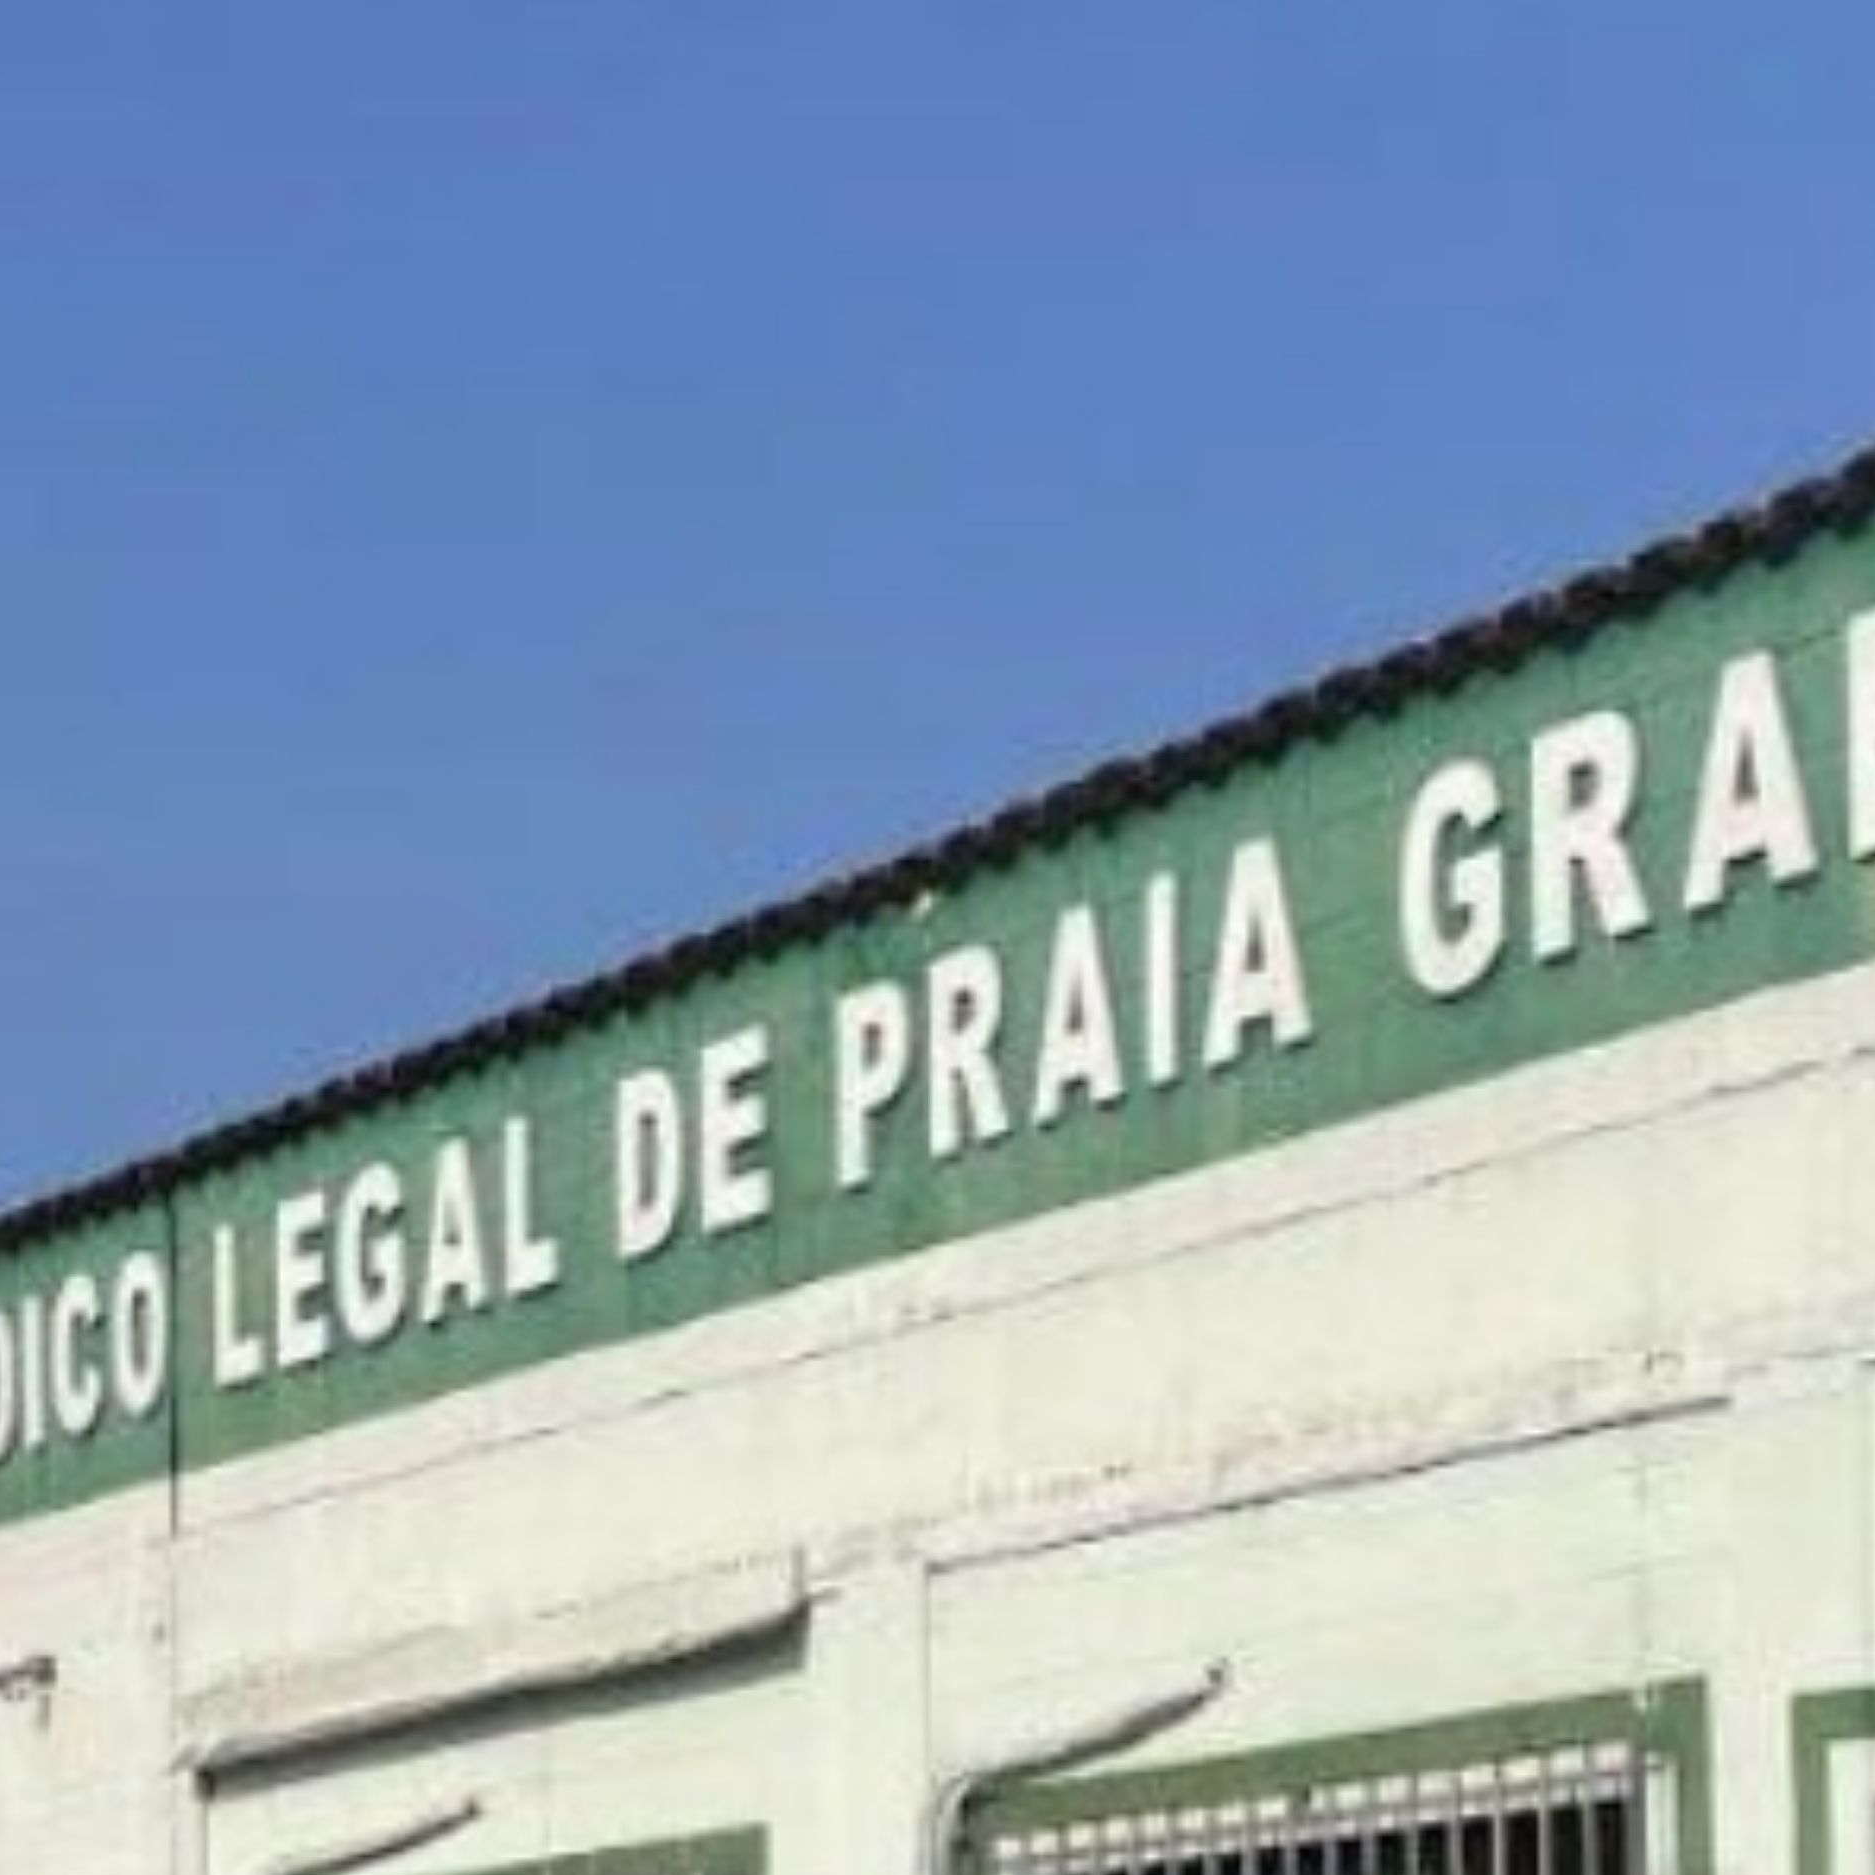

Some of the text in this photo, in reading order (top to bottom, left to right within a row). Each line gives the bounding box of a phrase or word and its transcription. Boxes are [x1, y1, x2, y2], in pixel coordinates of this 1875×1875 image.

[212, 1117, 560, 1389] LEGAL
[614, 1024, 773, 1260] DE
[835, 836, 1313, 1190] PRAIA
